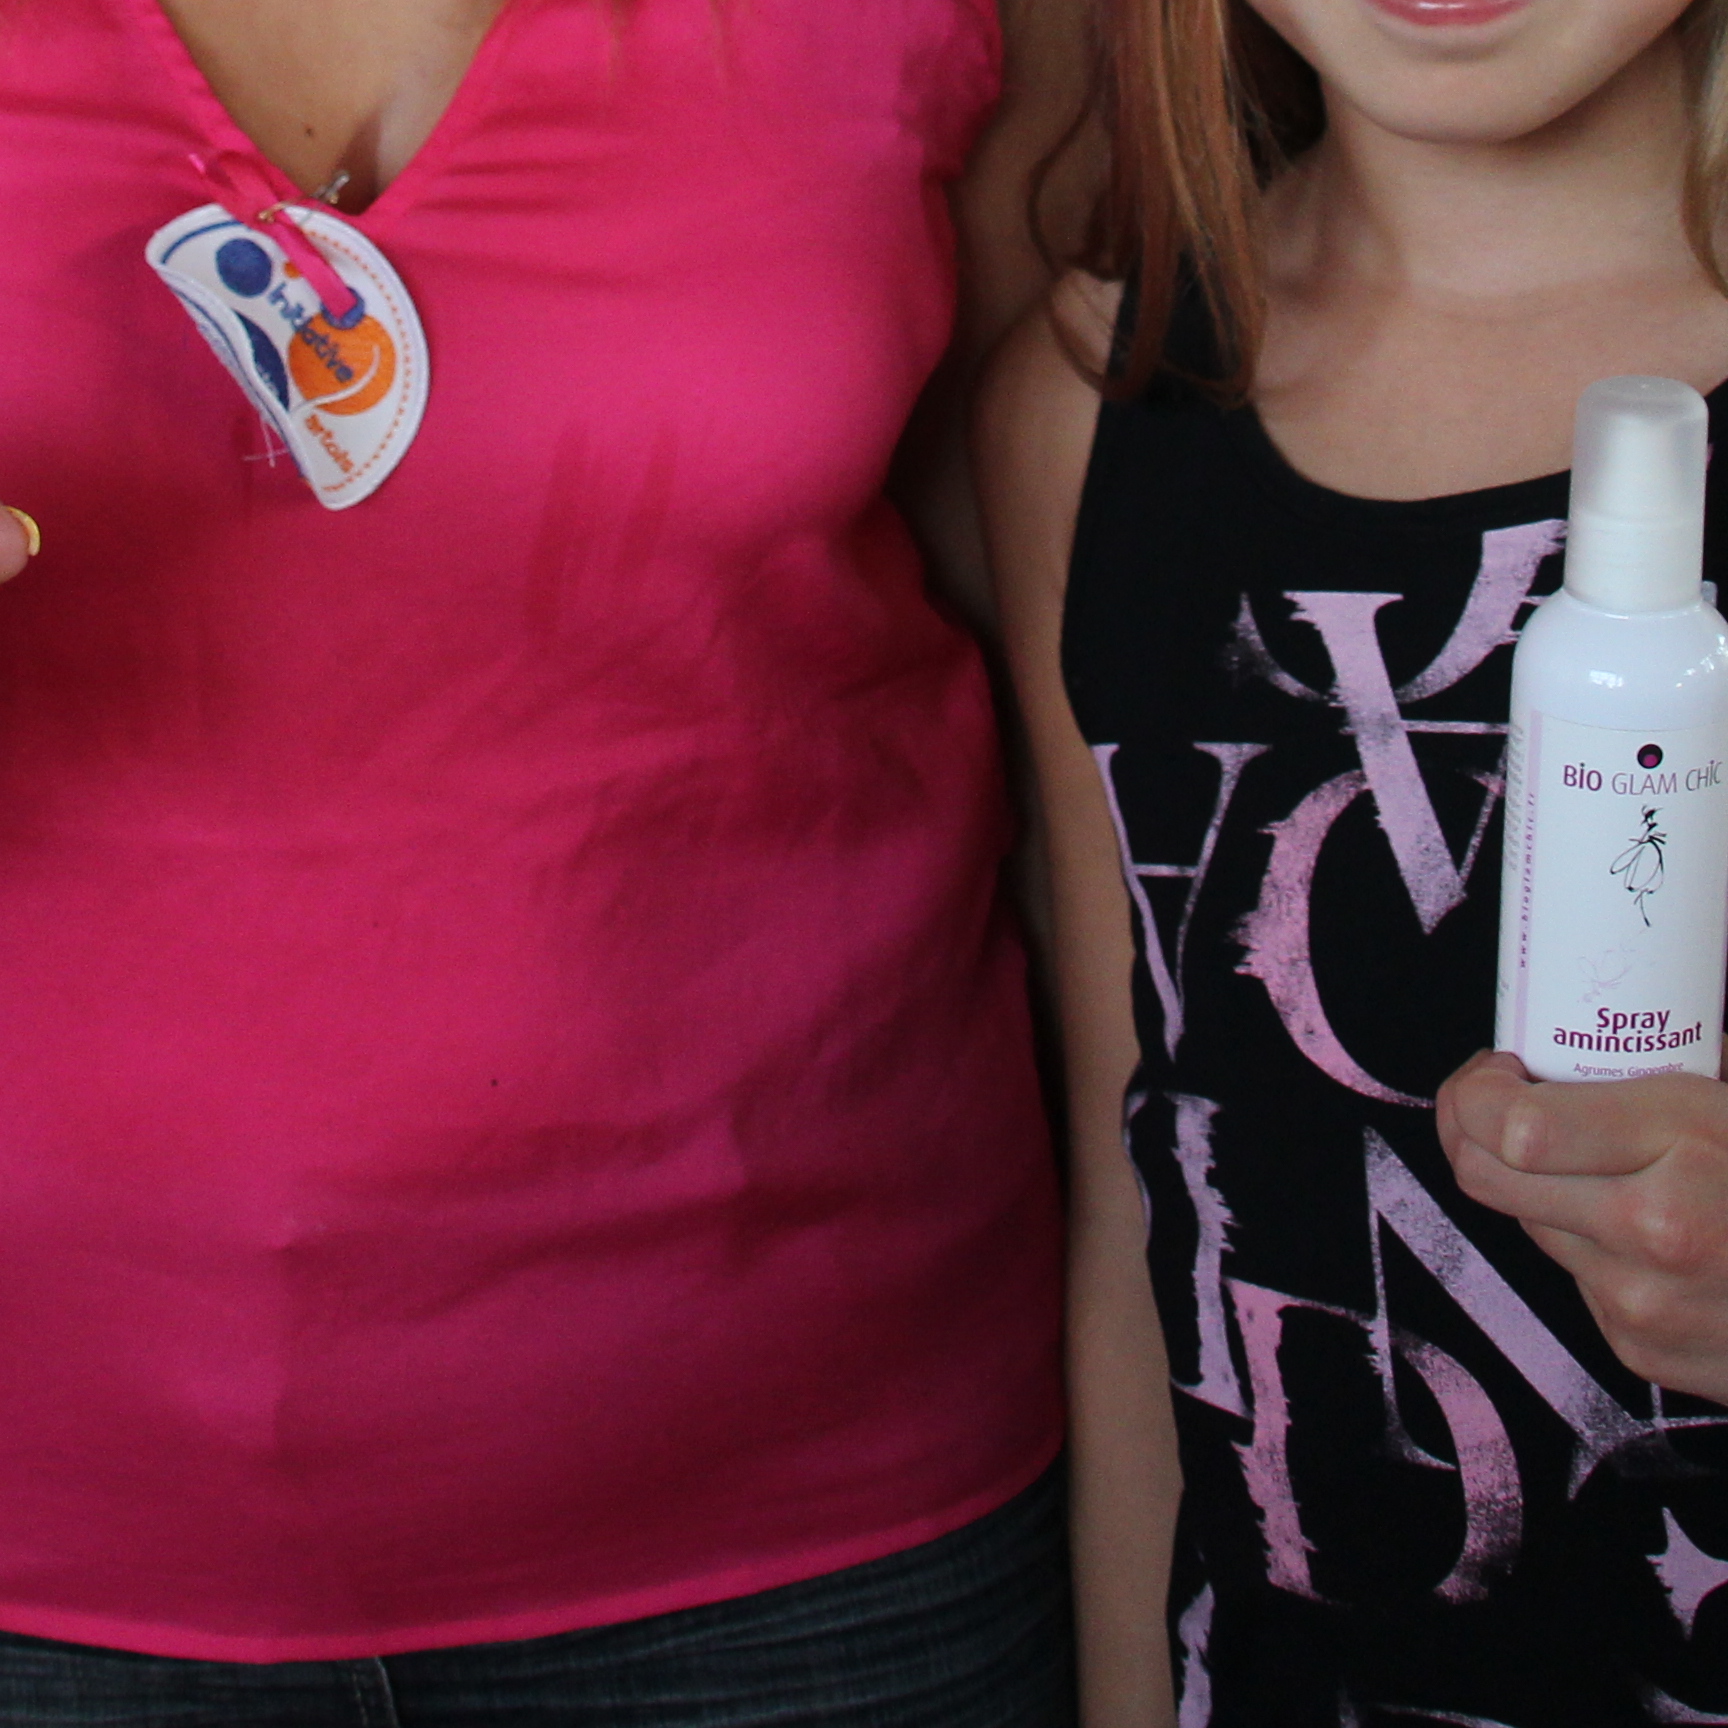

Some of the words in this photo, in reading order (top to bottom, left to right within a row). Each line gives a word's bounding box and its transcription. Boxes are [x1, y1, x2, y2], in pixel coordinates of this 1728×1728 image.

[1612, 772, 1677, 796] GLAM
[1596, 1007, 1670, 1035] Spray
[1553, 1021, 1702, 1053] amincissant
[1574, 1062, 1622, 1077] Agrumes
